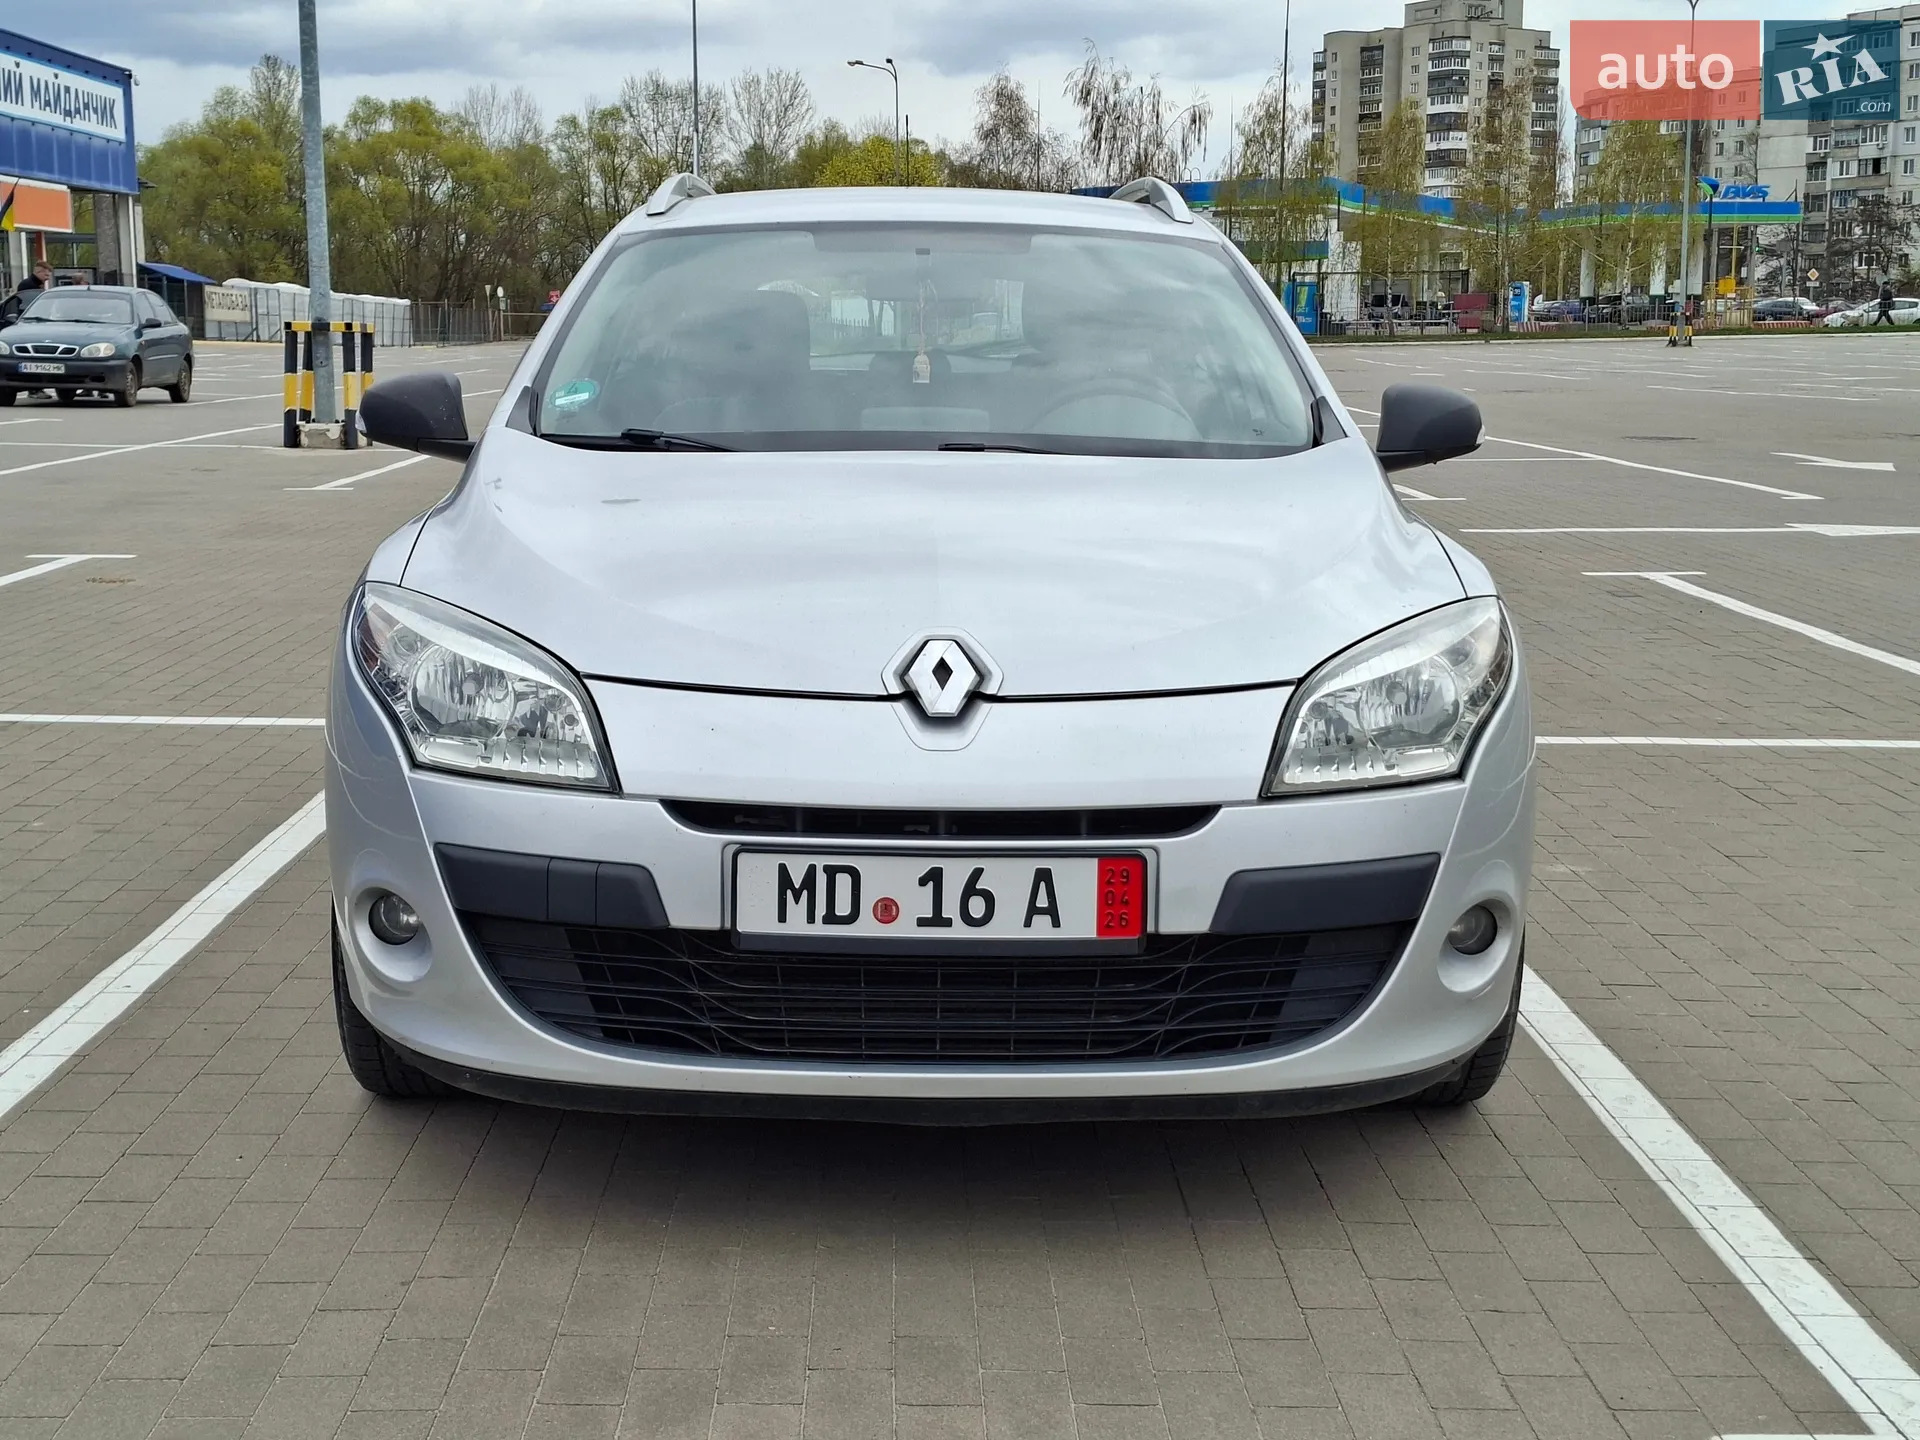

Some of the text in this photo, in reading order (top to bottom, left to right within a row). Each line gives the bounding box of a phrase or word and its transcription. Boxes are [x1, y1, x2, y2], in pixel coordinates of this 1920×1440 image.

[0, 61, 117, 129] ИЙ МАЙДАНЧИК
[1104, 868, 1131, 884] 29
[778, 862, 1061, 928] MD 16 A
[1104, 889, 1130, 907] 04
[1104, 911, 1129, 928] 26
